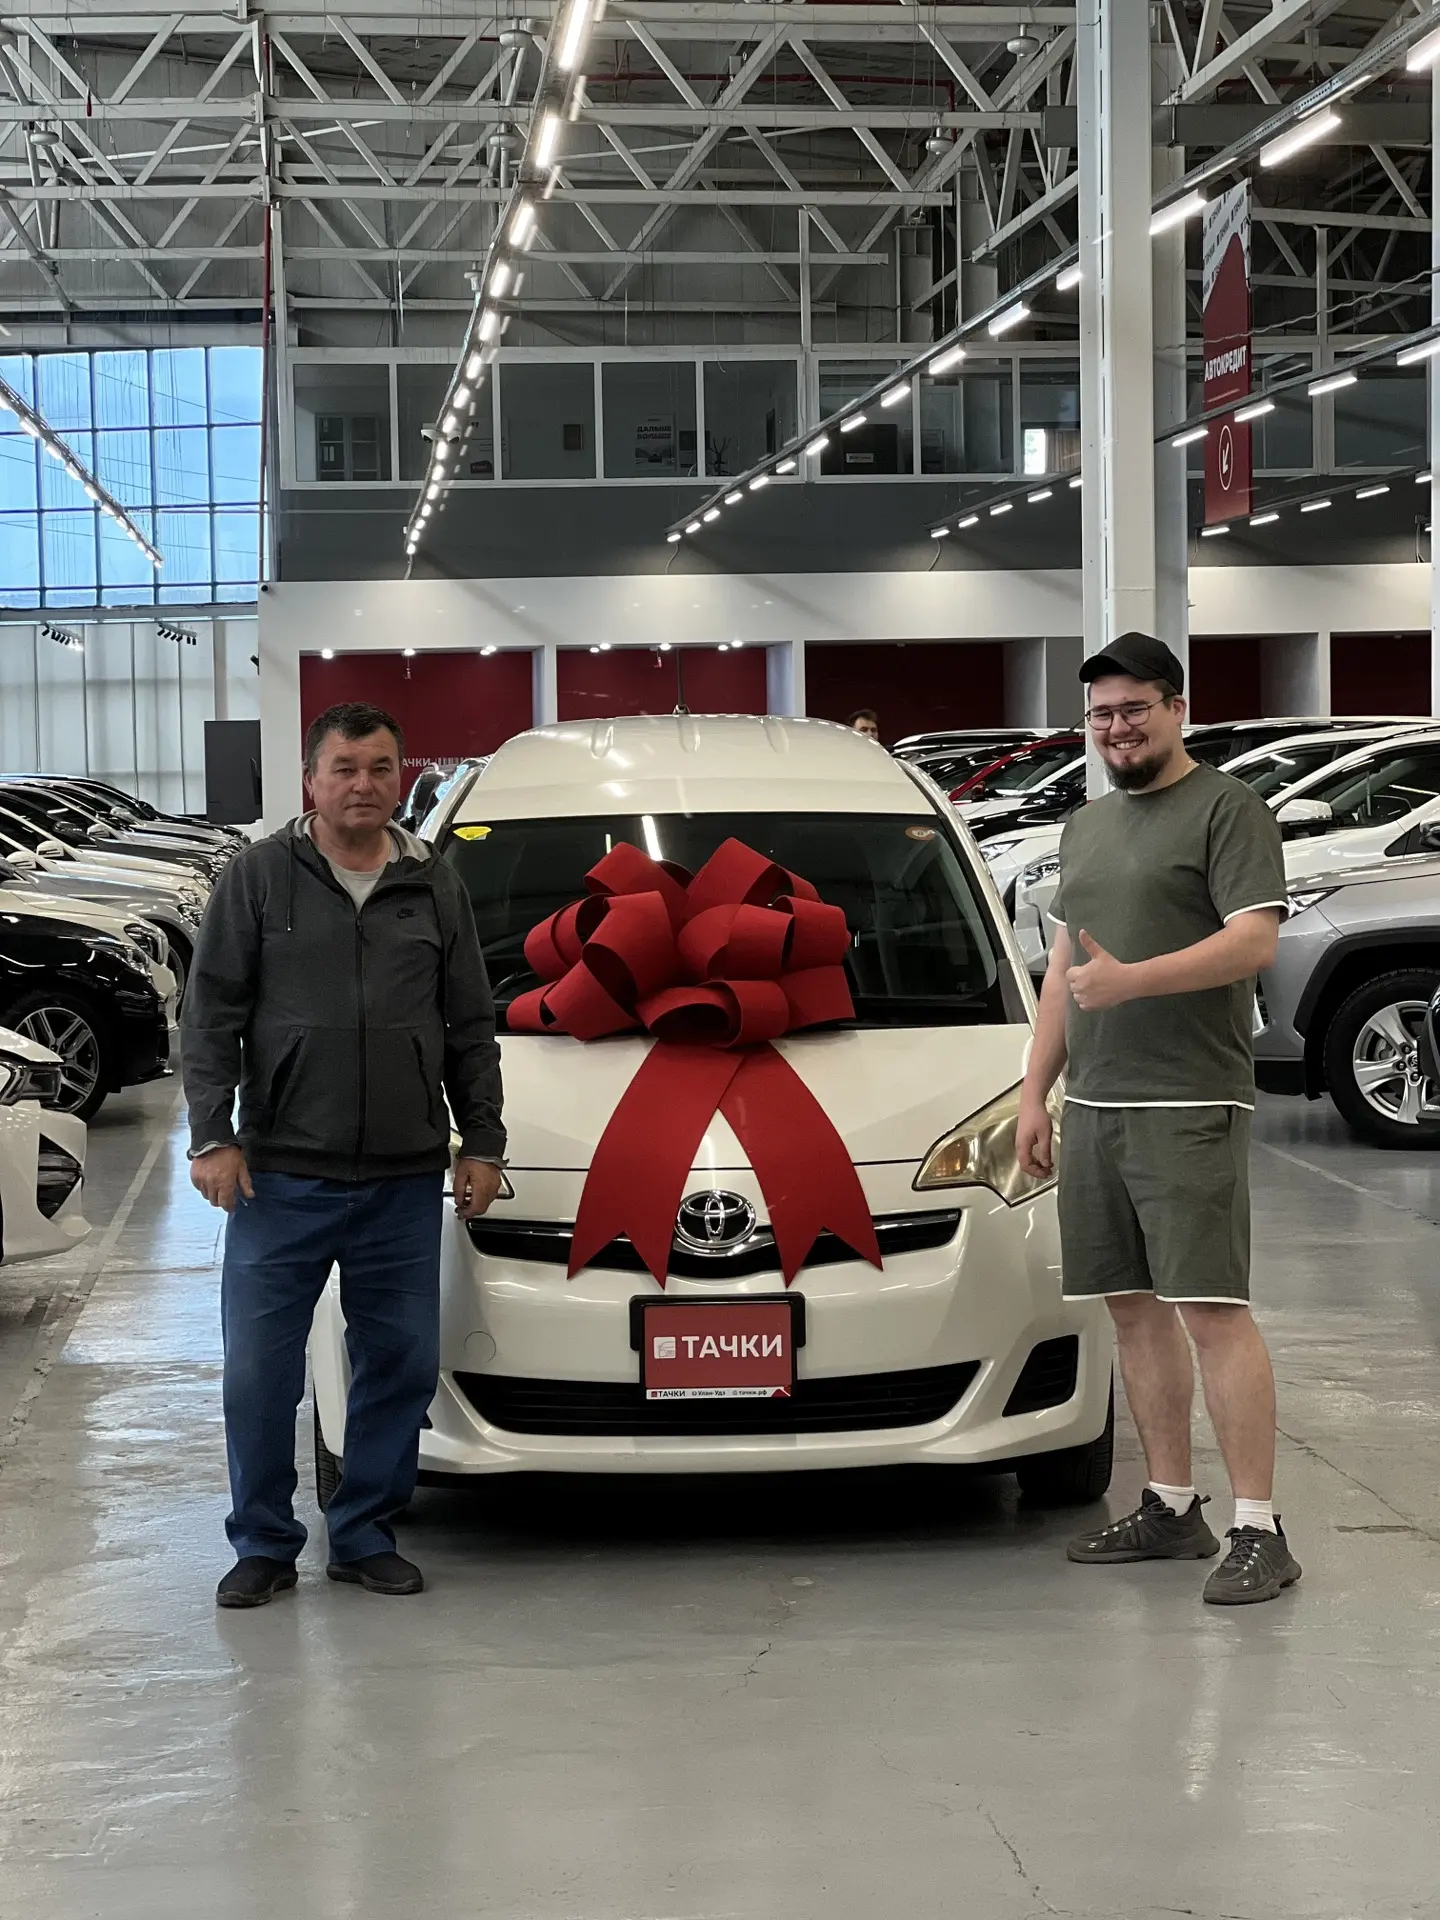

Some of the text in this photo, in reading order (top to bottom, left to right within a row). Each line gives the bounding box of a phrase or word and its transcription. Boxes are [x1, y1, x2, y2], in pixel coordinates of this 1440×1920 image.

[1204, 345, 1247, 383] АВТОКРЕДИТ
[402, 757, 431, 768] АЧКИ
[681, 1334, 783, 1359] ТАЧКИ
[658, 1390, 686, 1398] ТАЧКИ
[739, 1389, 767, 1397] тачки.рф
